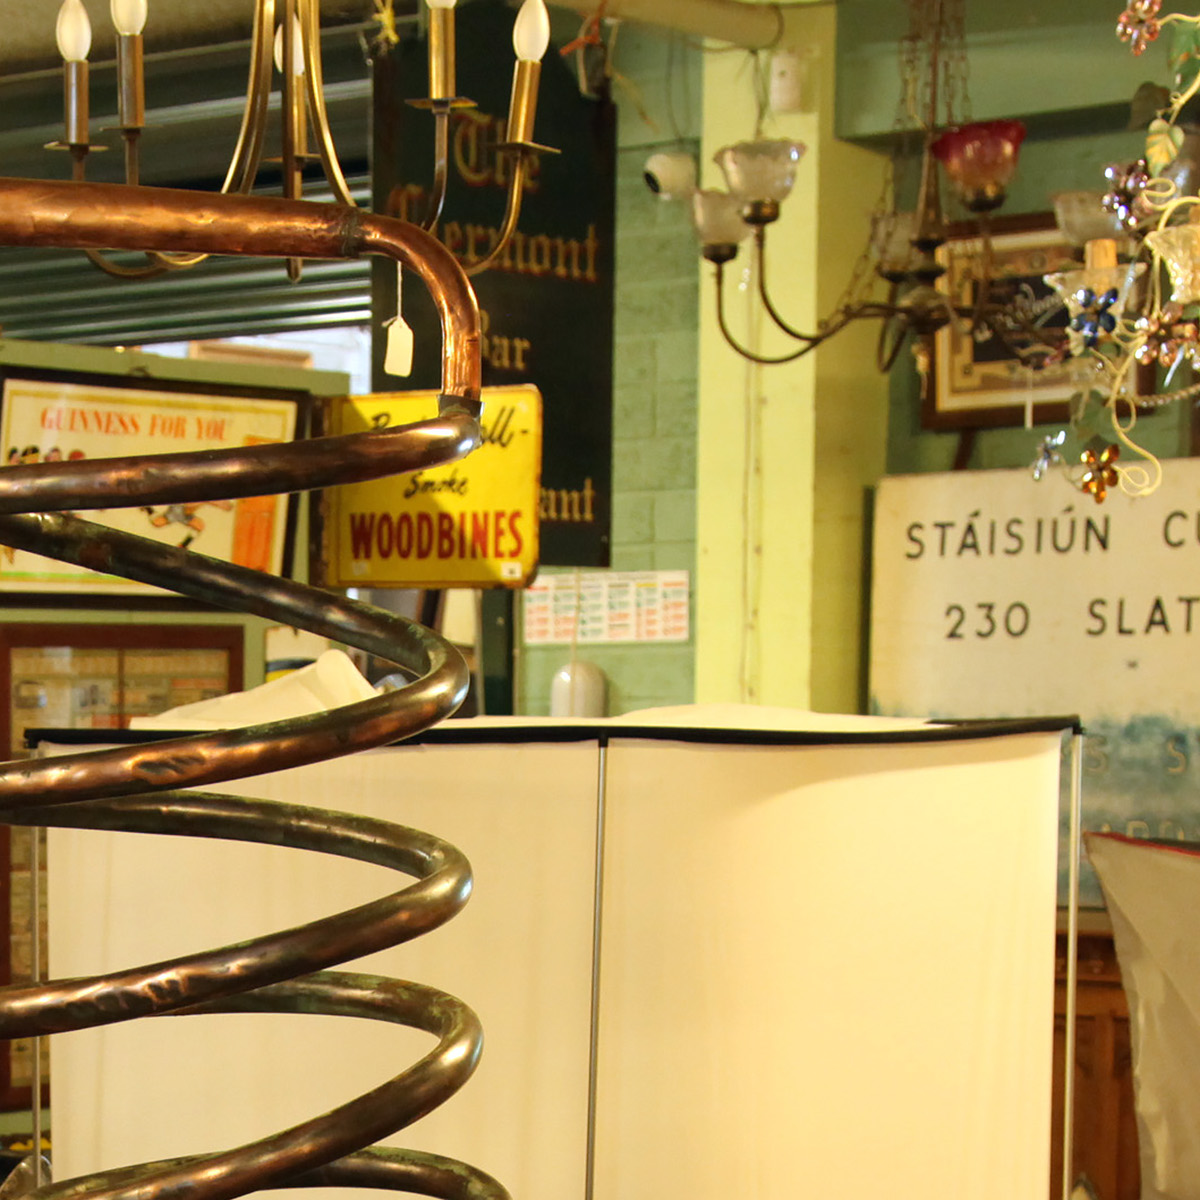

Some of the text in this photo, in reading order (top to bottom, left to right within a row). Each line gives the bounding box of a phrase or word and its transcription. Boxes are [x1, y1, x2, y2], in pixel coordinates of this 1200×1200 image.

[40, 406, 233, 441] GUINNESS FOR YOU
[403, 468, 469, 499] Smoke
[350, 509, 524, 560] WOODBINES
[904, 504, 1200, 560] STÁISIÚN C
[944, 601, 1031, 640] 230
